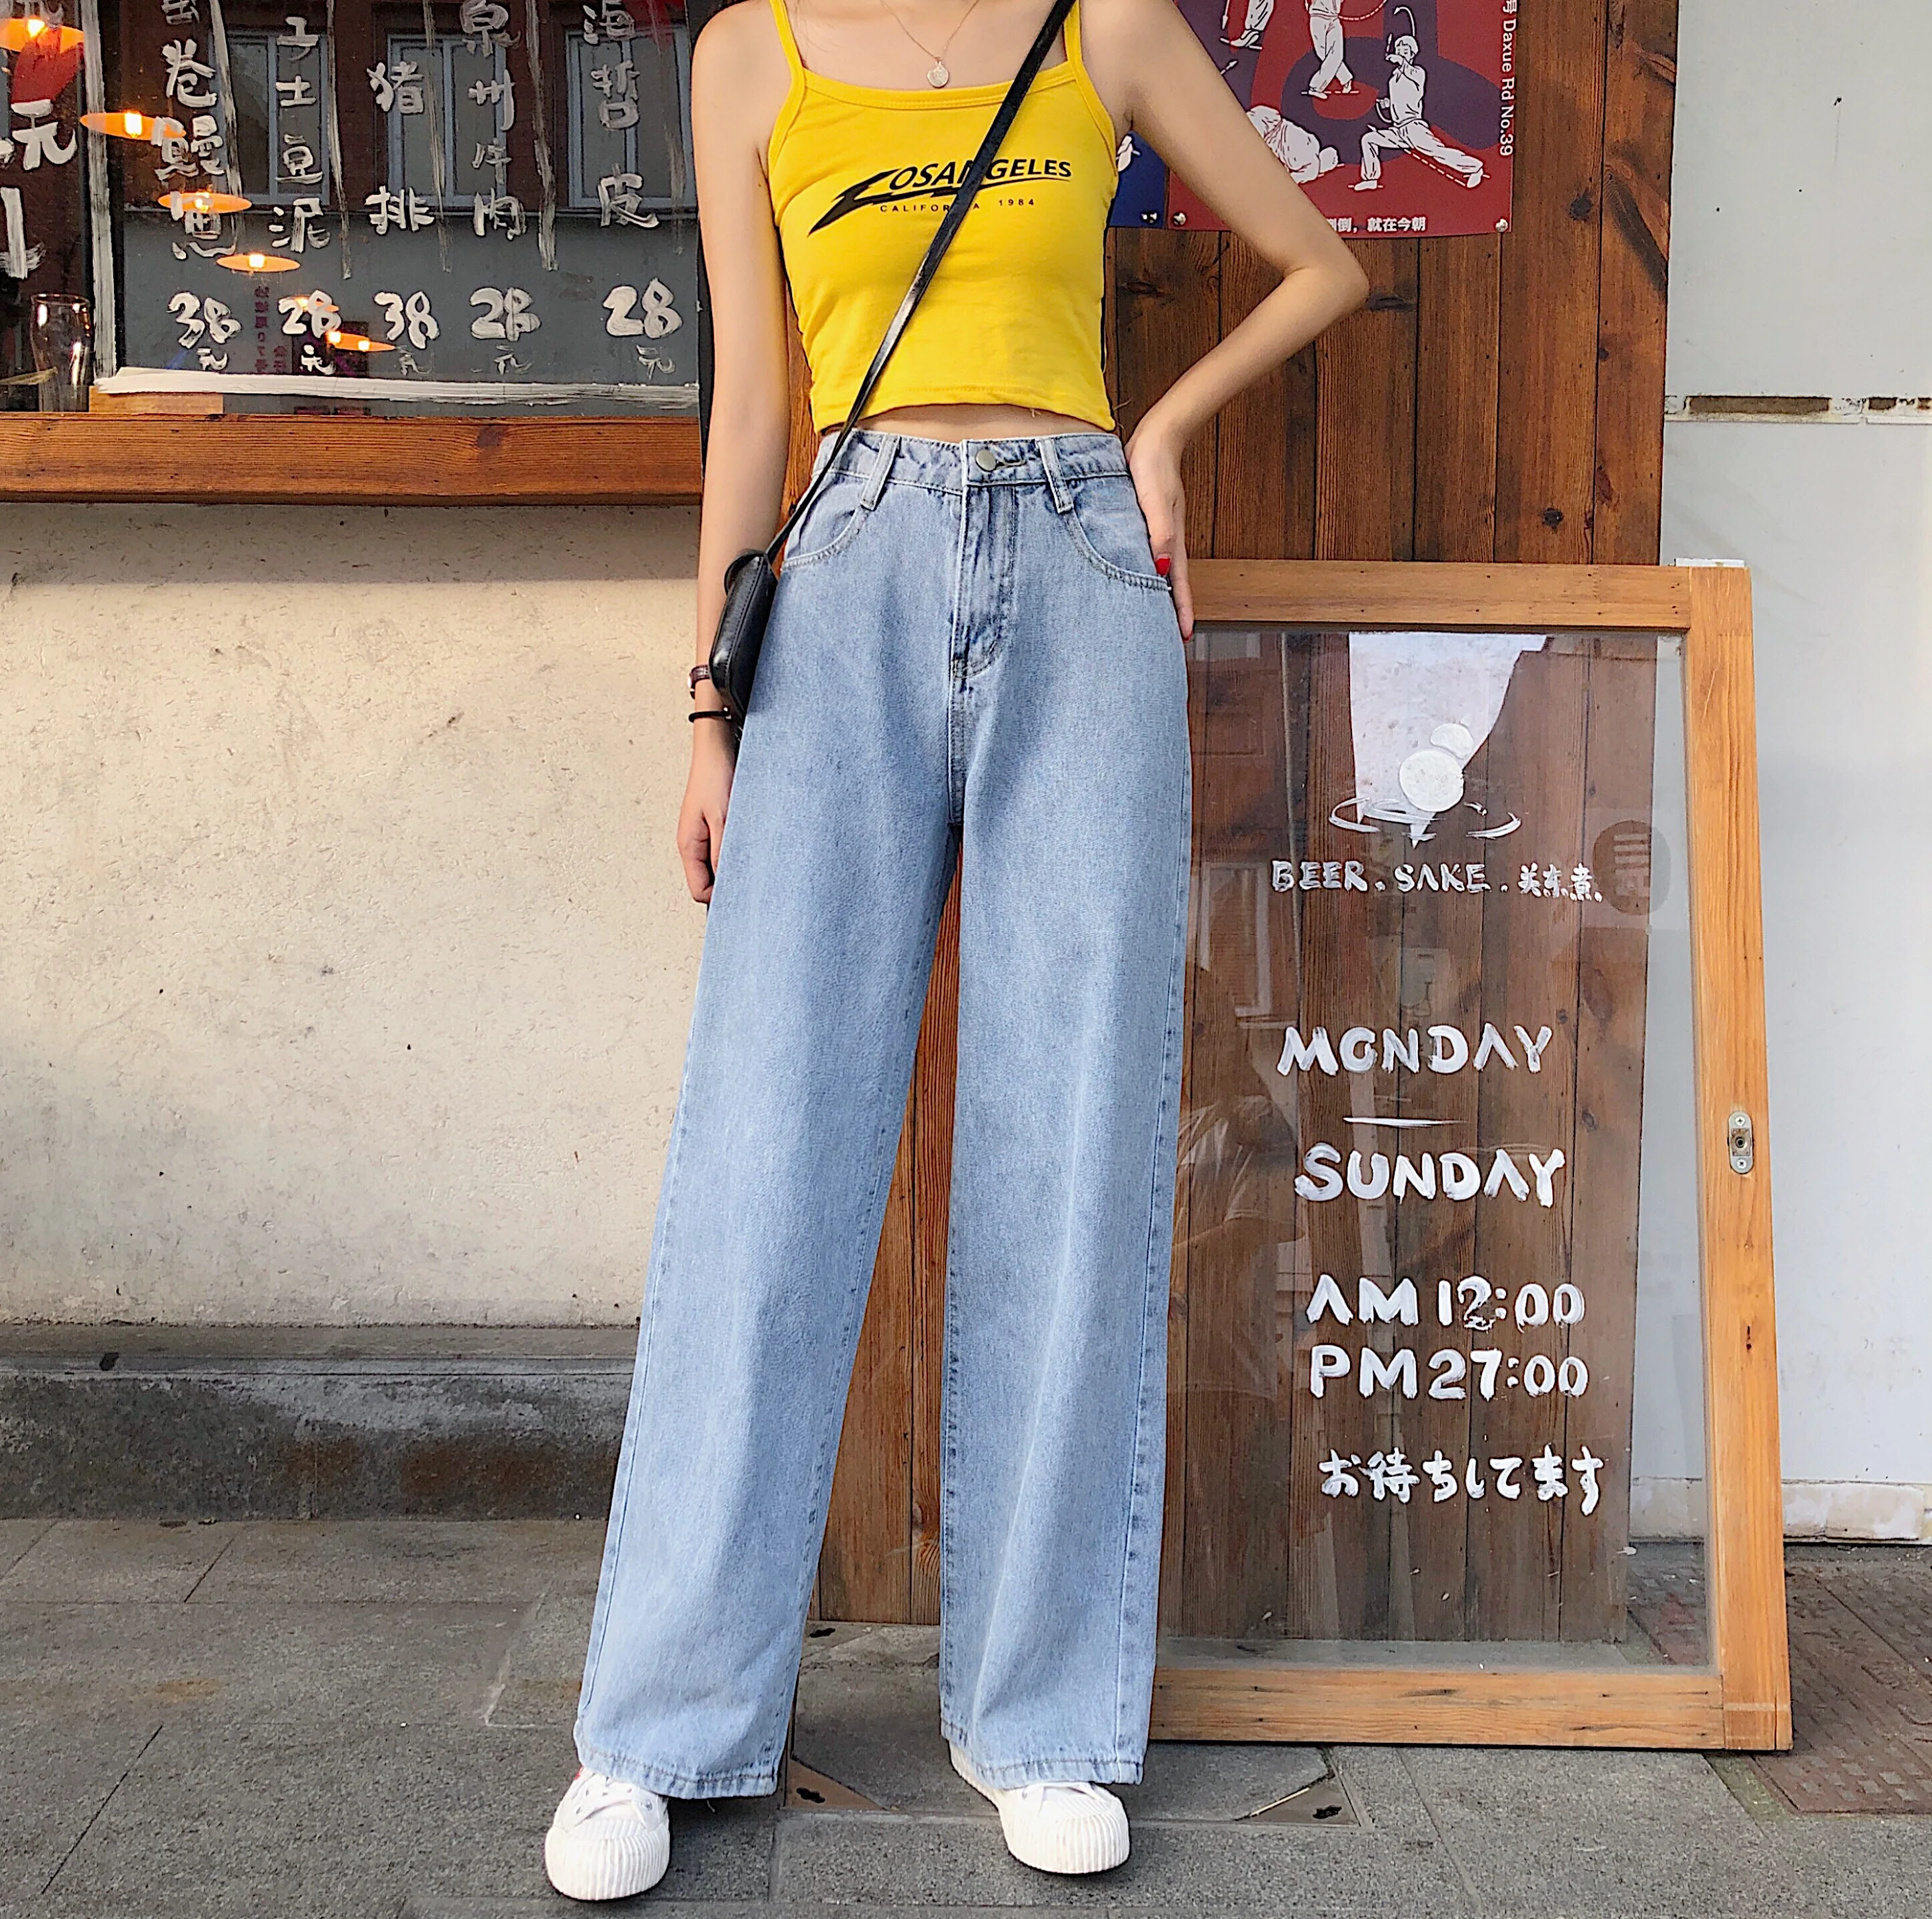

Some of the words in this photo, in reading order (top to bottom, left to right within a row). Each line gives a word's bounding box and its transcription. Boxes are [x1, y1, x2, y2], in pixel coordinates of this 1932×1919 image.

[1501, 18, 1517, 73] Daxue
[1501, 76, 1515, 101] Rd
[1499, 105, 1514, 156] No.39
[880, 203, 980, 213] CALIFORA
[999, 198, 1034, 206] 1984
[166, 291, 241, 349] 38
[277, 289, 342, 339] 28
[374, 290, 440, 349] 38
[469, 287, 541, 341] 28
[602, 277, 683, 339] 28
[1277, 1023, 1553, 1076] MONDAY
[1295, 1142, 1565, 1208] SUNDAY
[1306, 1274, 1419, 1326] AM
[1438, 1275, 1585, 1333] 12:00
[1310, 1344, 1418, 1398] PM
[1429, 1348, 1589, 1401] 27:00
[1319, 1444, 1604, 1516] お待ちしてます
